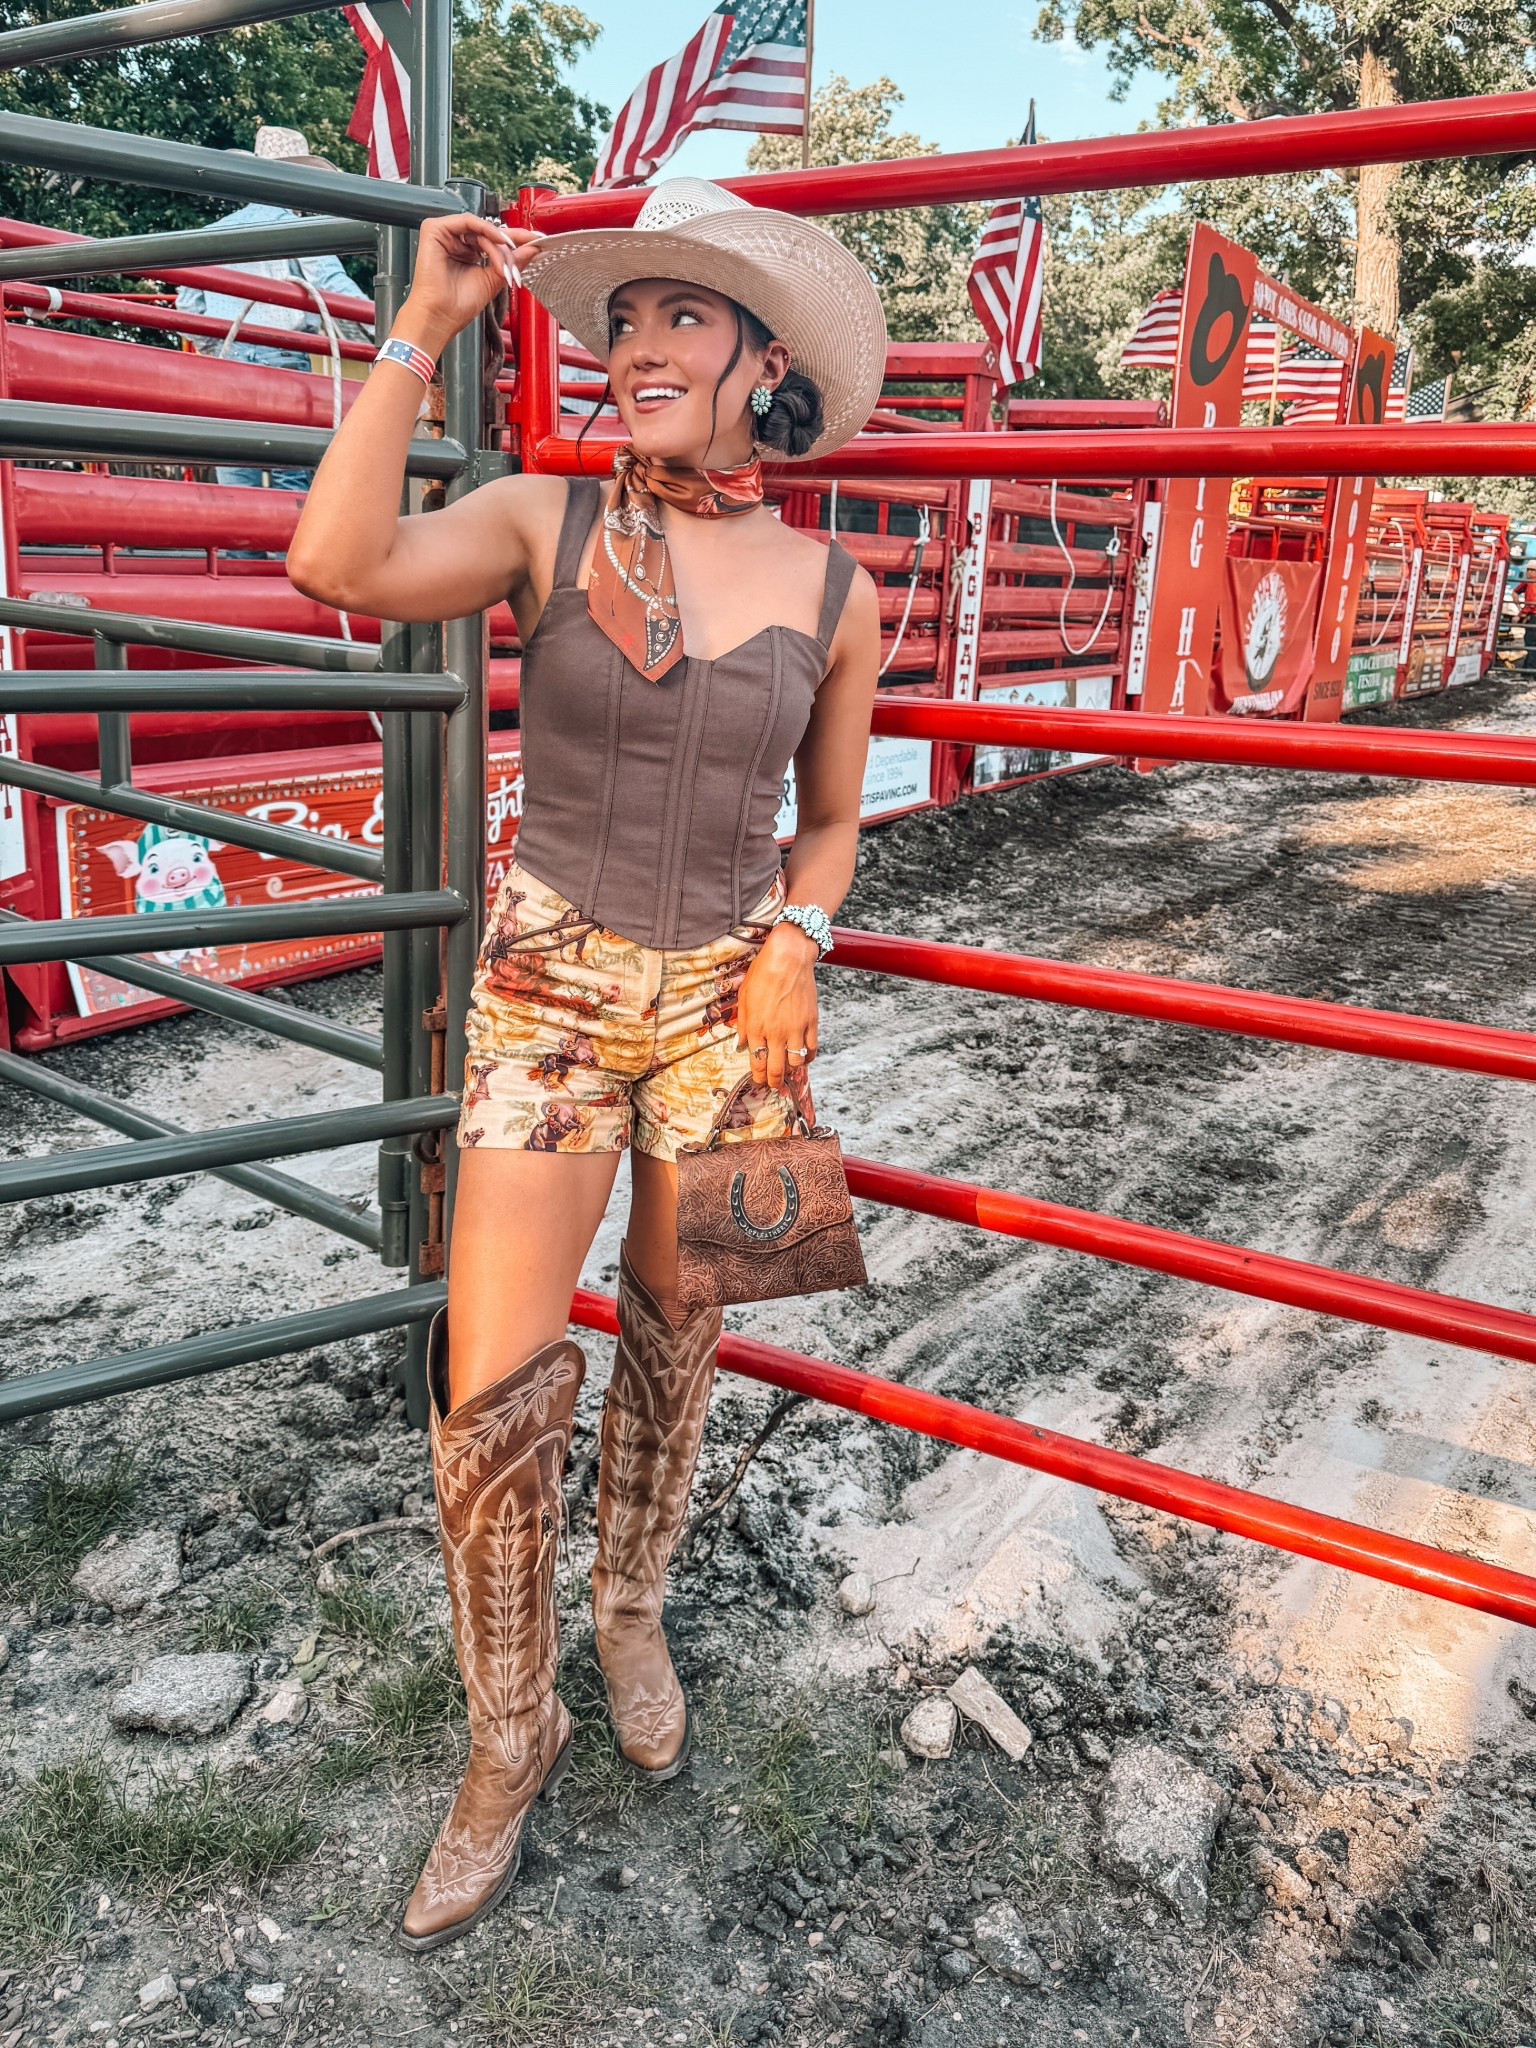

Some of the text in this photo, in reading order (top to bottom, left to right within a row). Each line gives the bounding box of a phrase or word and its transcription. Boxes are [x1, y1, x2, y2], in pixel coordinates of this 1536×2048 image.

[960, 512, 982, 695] BIG HAT
[875, 747, 918, 768] Dependable
